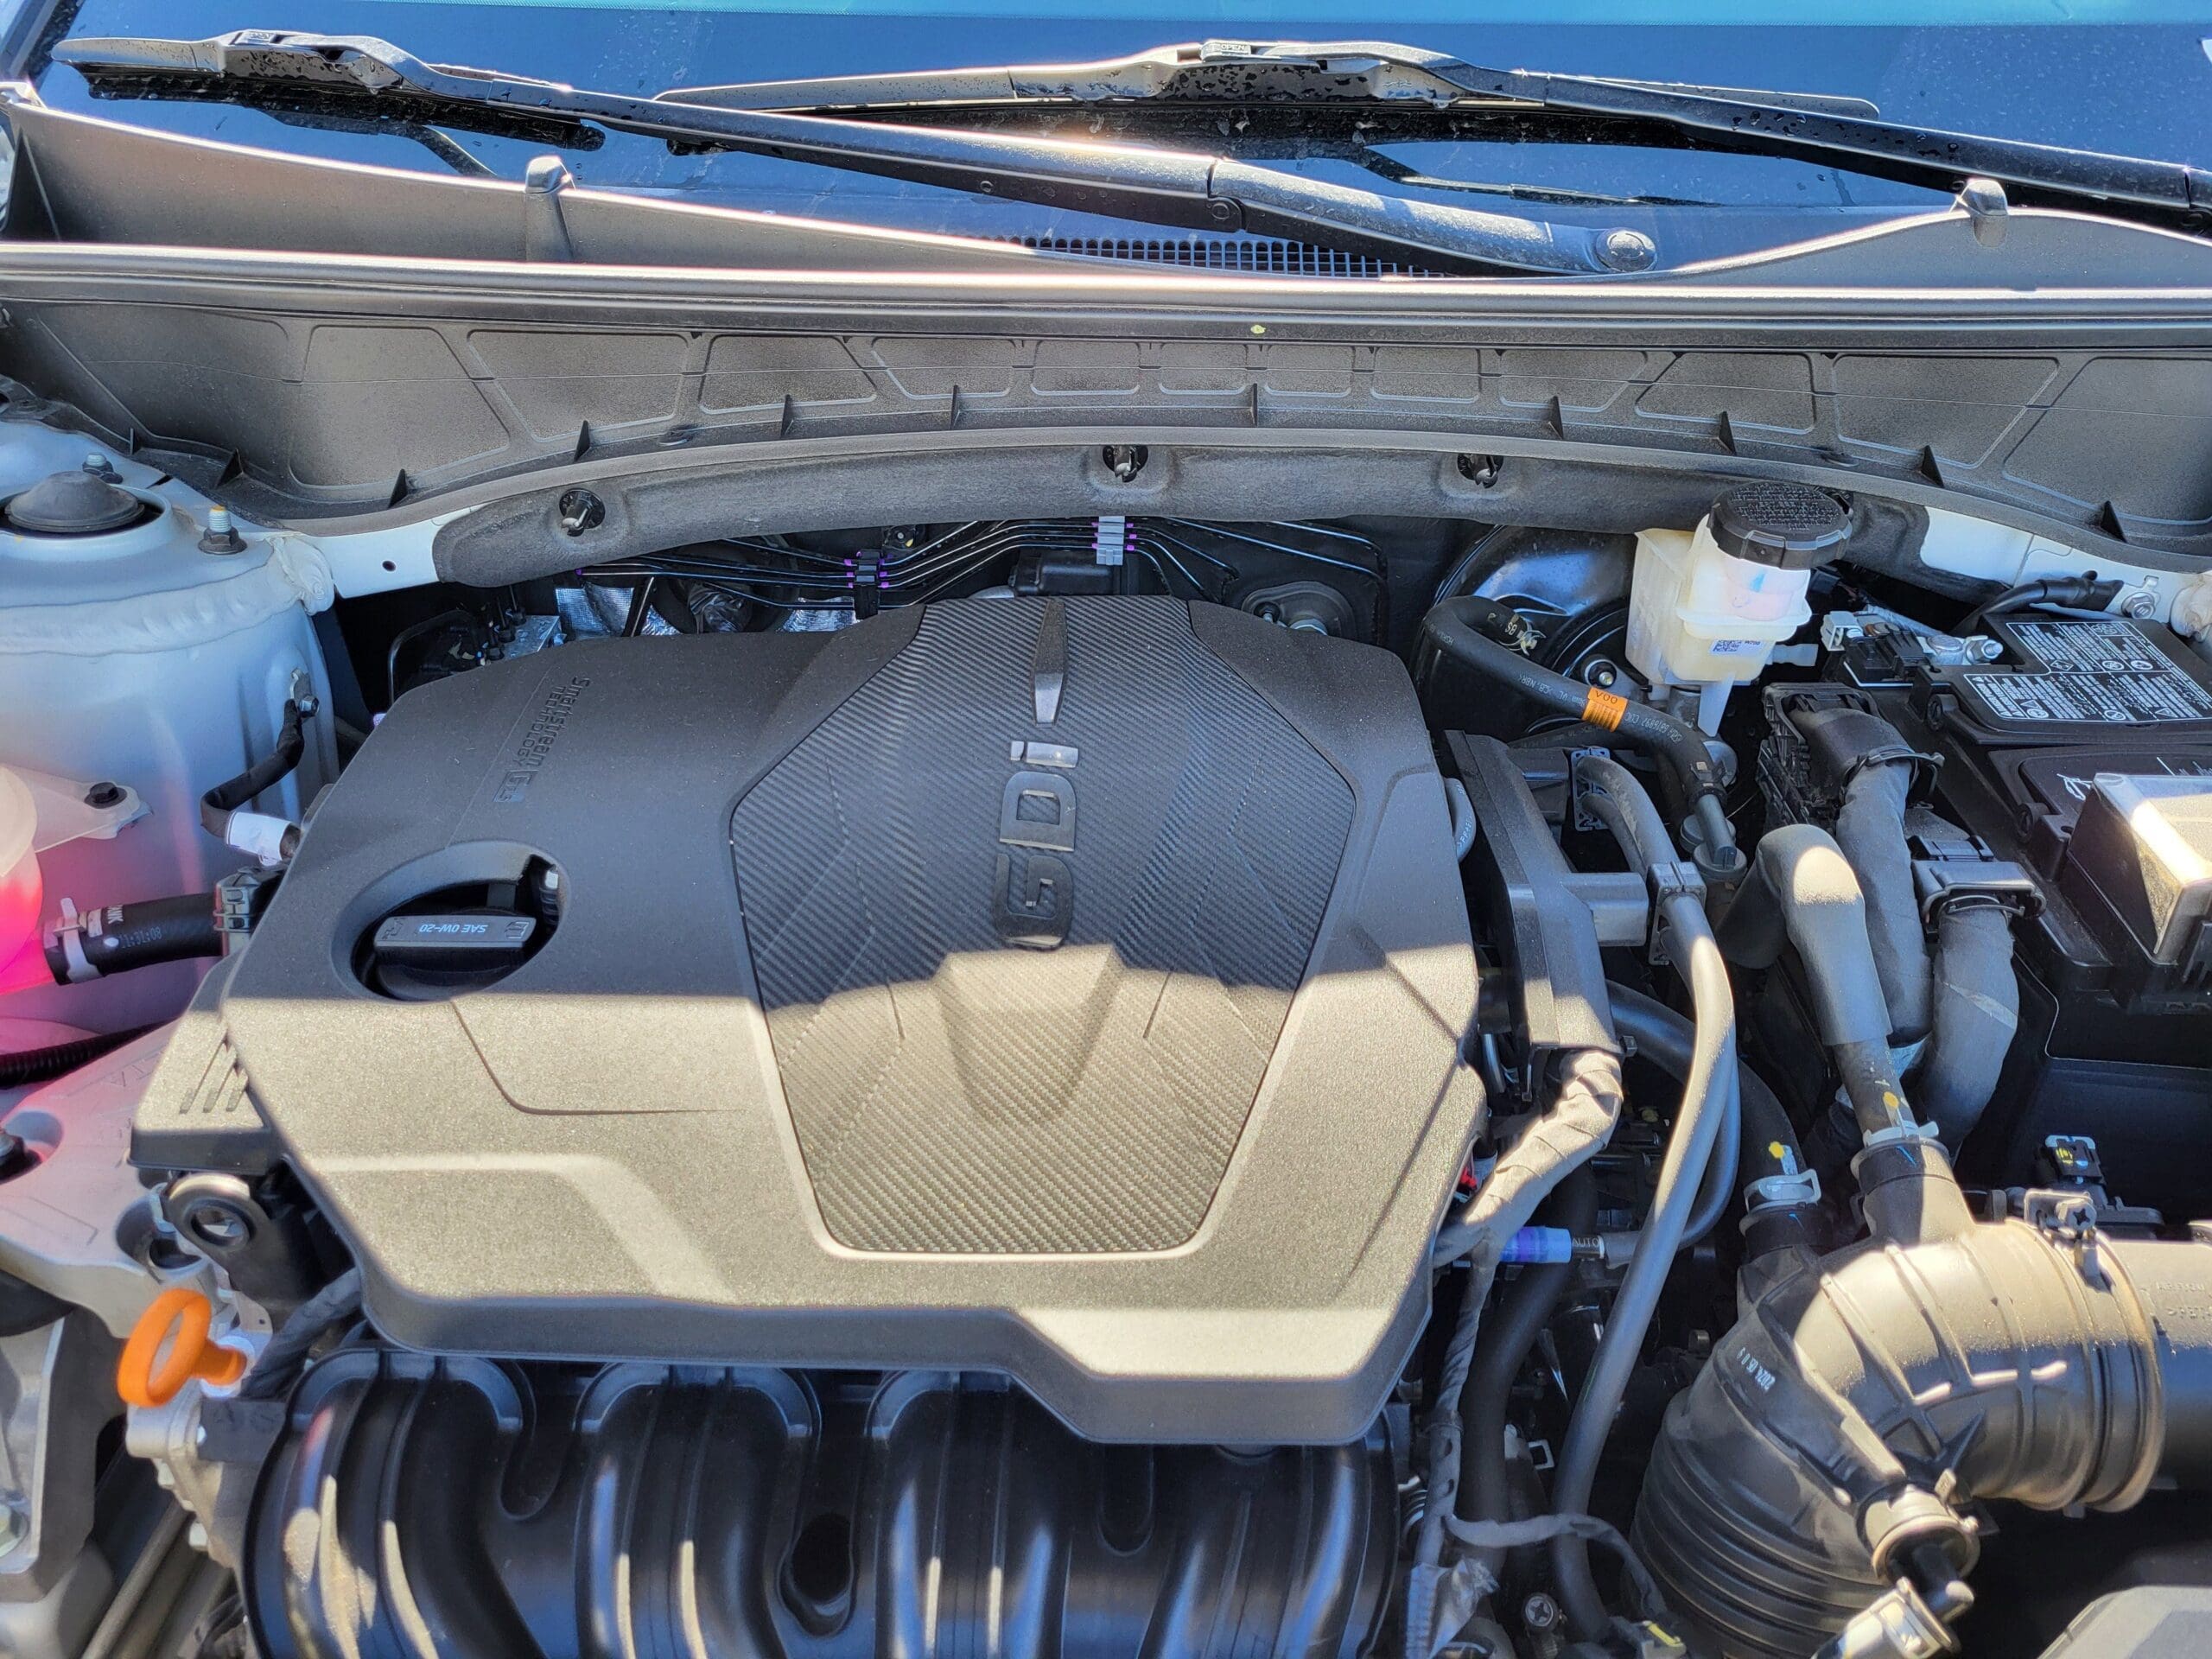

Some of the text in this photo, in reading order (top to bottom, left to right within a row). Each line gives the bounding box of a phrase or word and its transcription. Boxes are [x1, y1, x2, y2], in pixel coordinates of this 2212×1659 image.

[526, 676, 591, 767] Smartstream
[418, 924, 488, 933] SAE 0W-20
